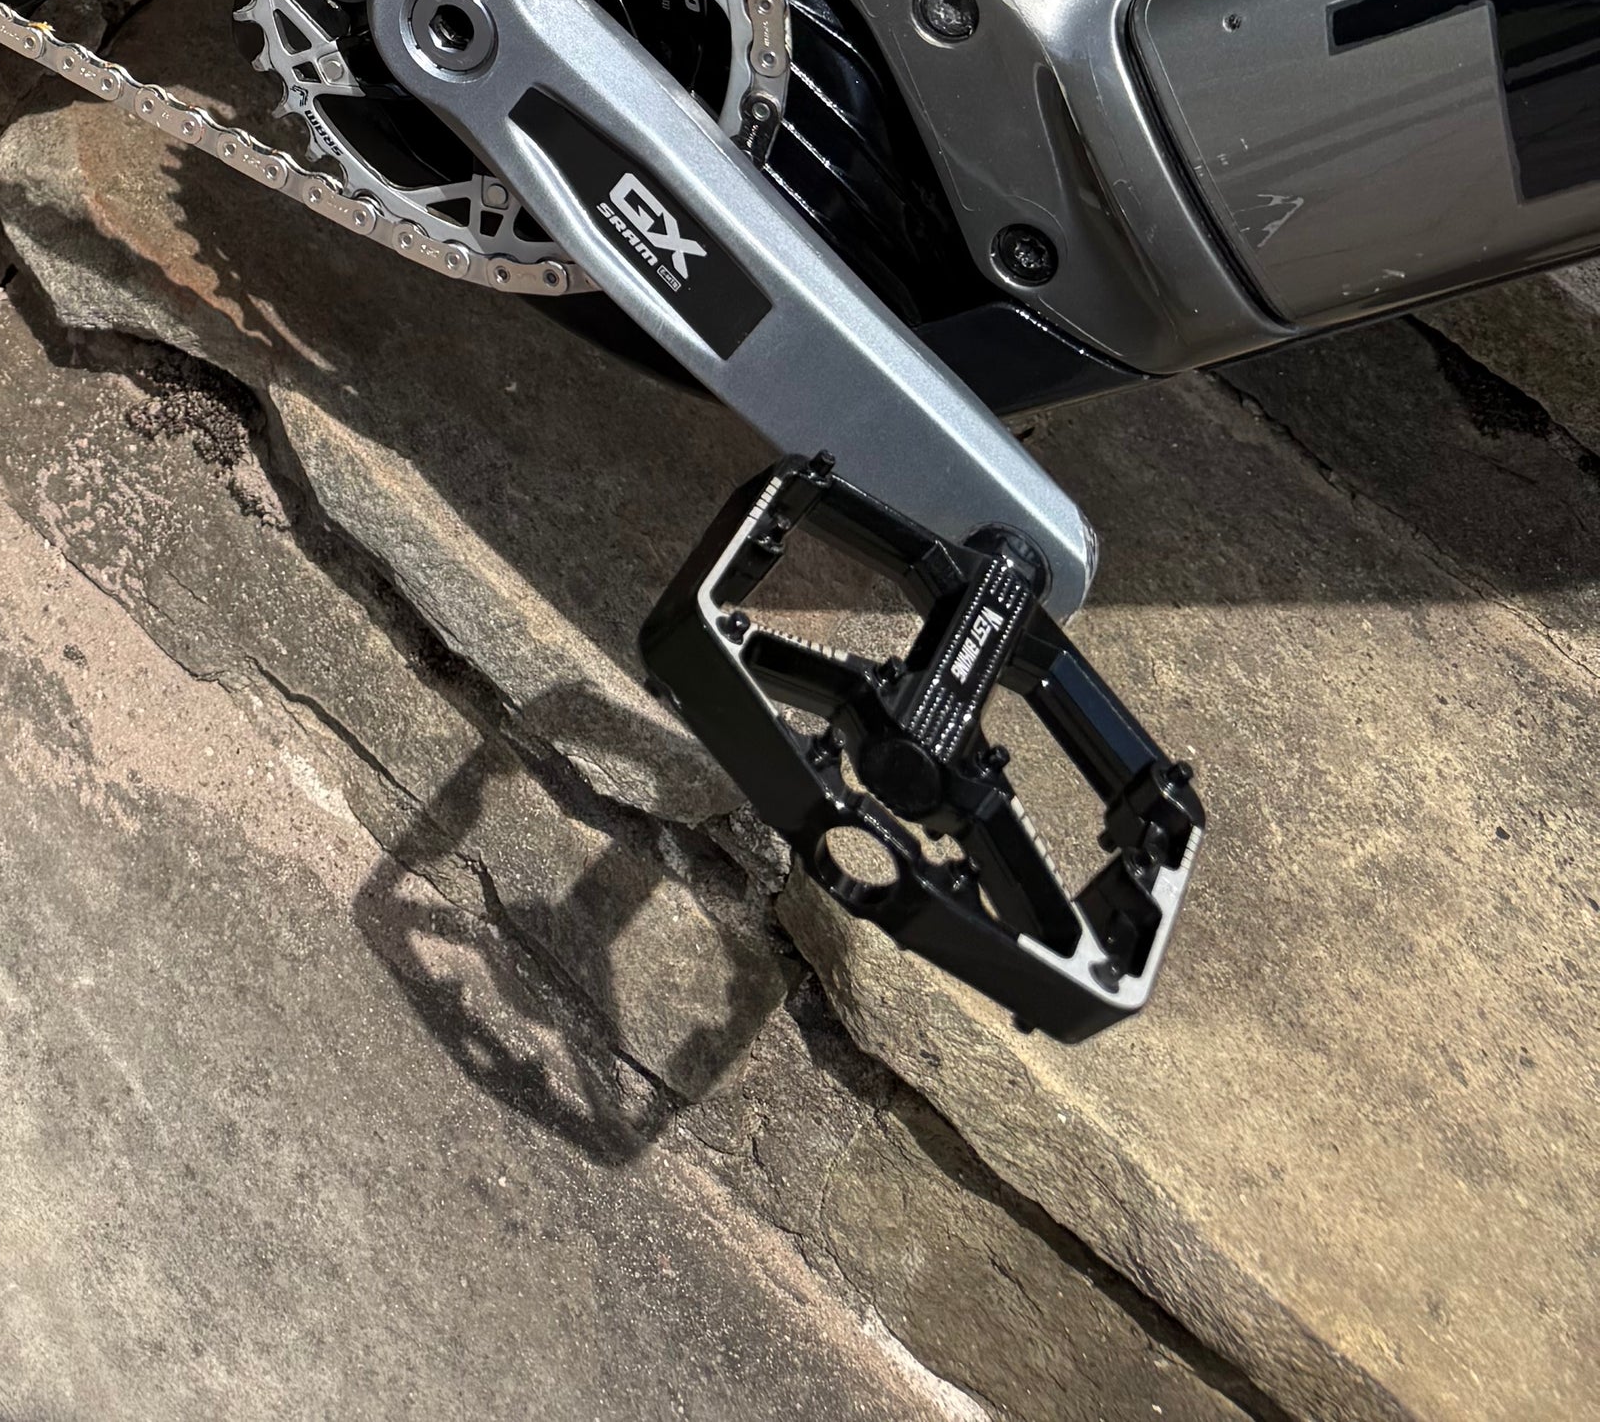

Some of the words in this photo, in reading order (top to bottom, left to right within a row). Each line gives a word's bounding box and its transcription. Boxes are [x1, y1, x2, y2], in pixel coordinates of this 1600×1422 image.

[304, 109, 344, 156] SRAM
[596, 202, 659, 266] SRAM
[609, 172, 707, 279] GX
[969, 606, 1003, 651] WEST
